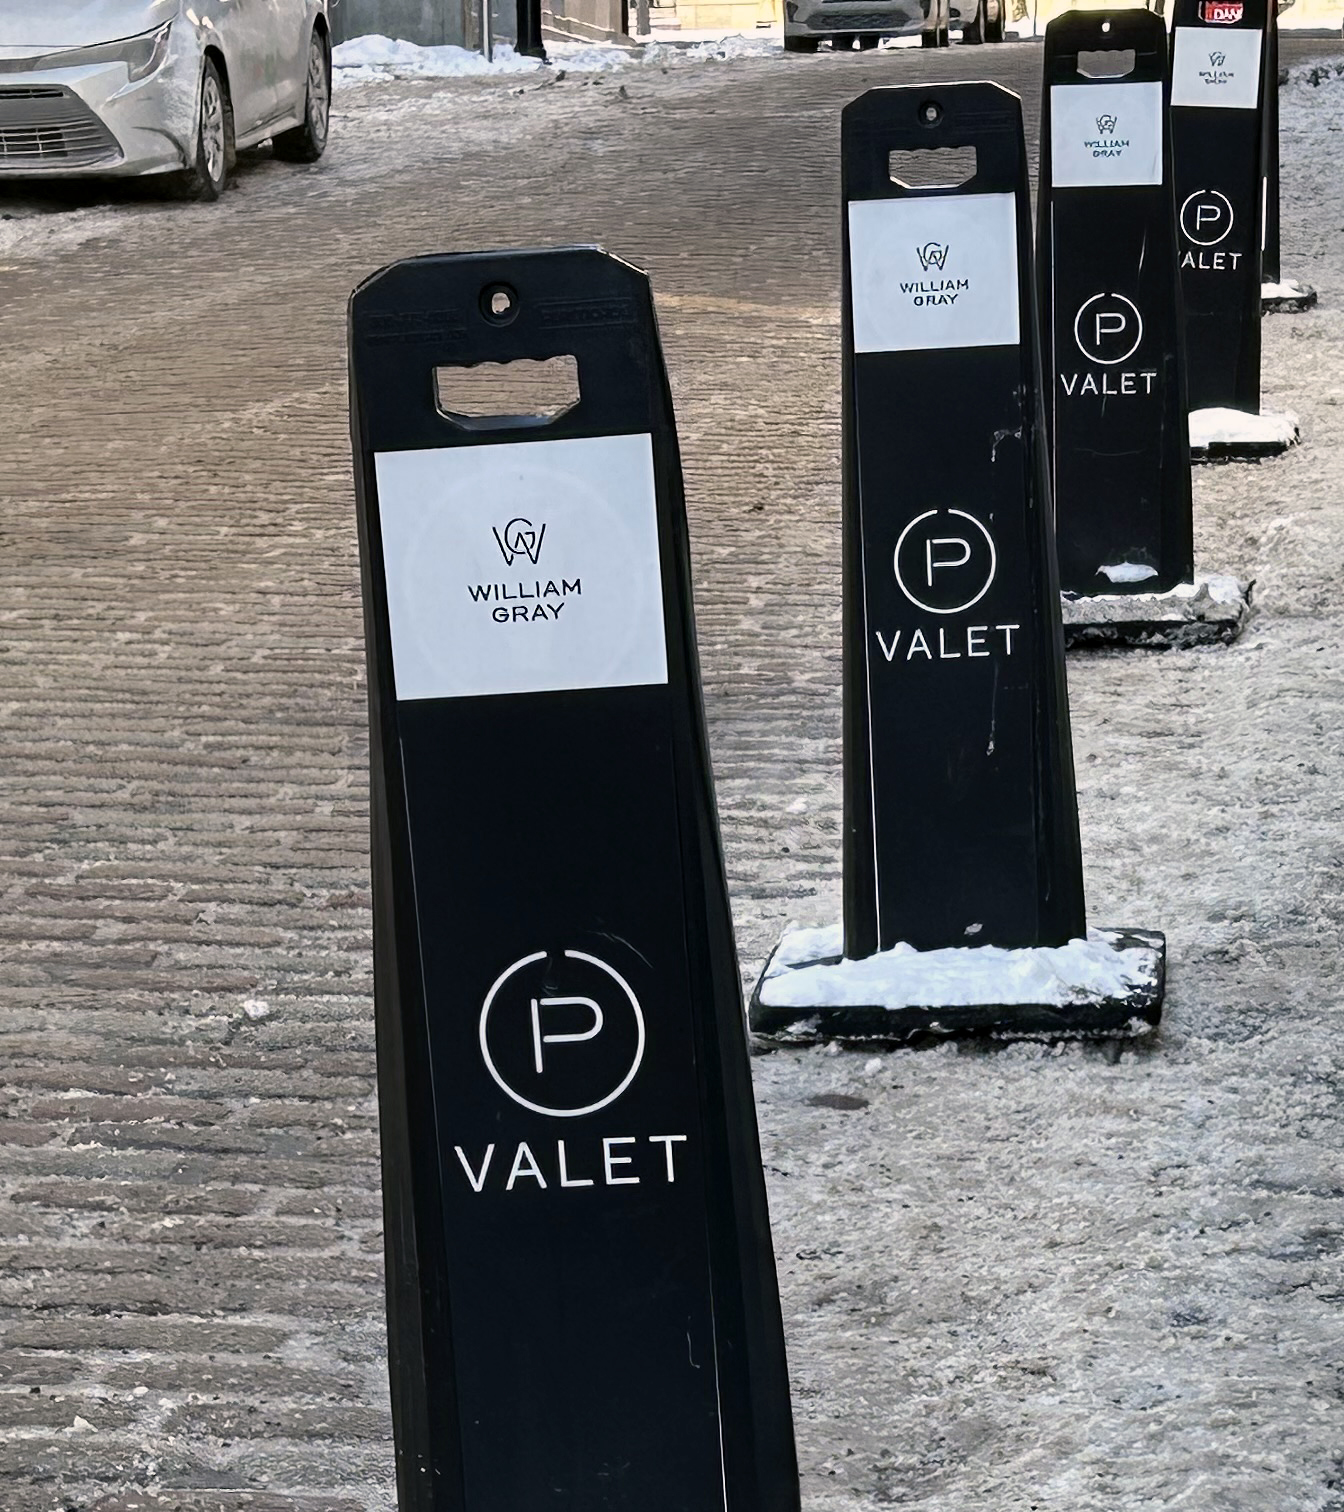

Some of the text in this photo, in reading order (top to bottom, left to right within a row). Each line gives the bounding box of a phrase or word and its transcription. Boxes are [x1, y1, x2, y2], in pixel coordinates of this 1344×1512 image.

[1177, 250, 1243, 270] ALET
[899, 278, 969, 294] WILLIAM
[1060, 372, 1157, 396] VALET
[467, 578, 582, 602] WILLIAM
[492, 602, 565, 623] GRAY
[875, 624, 1021, 662] VALET
[453, 1134, 688, 1193] VALET
